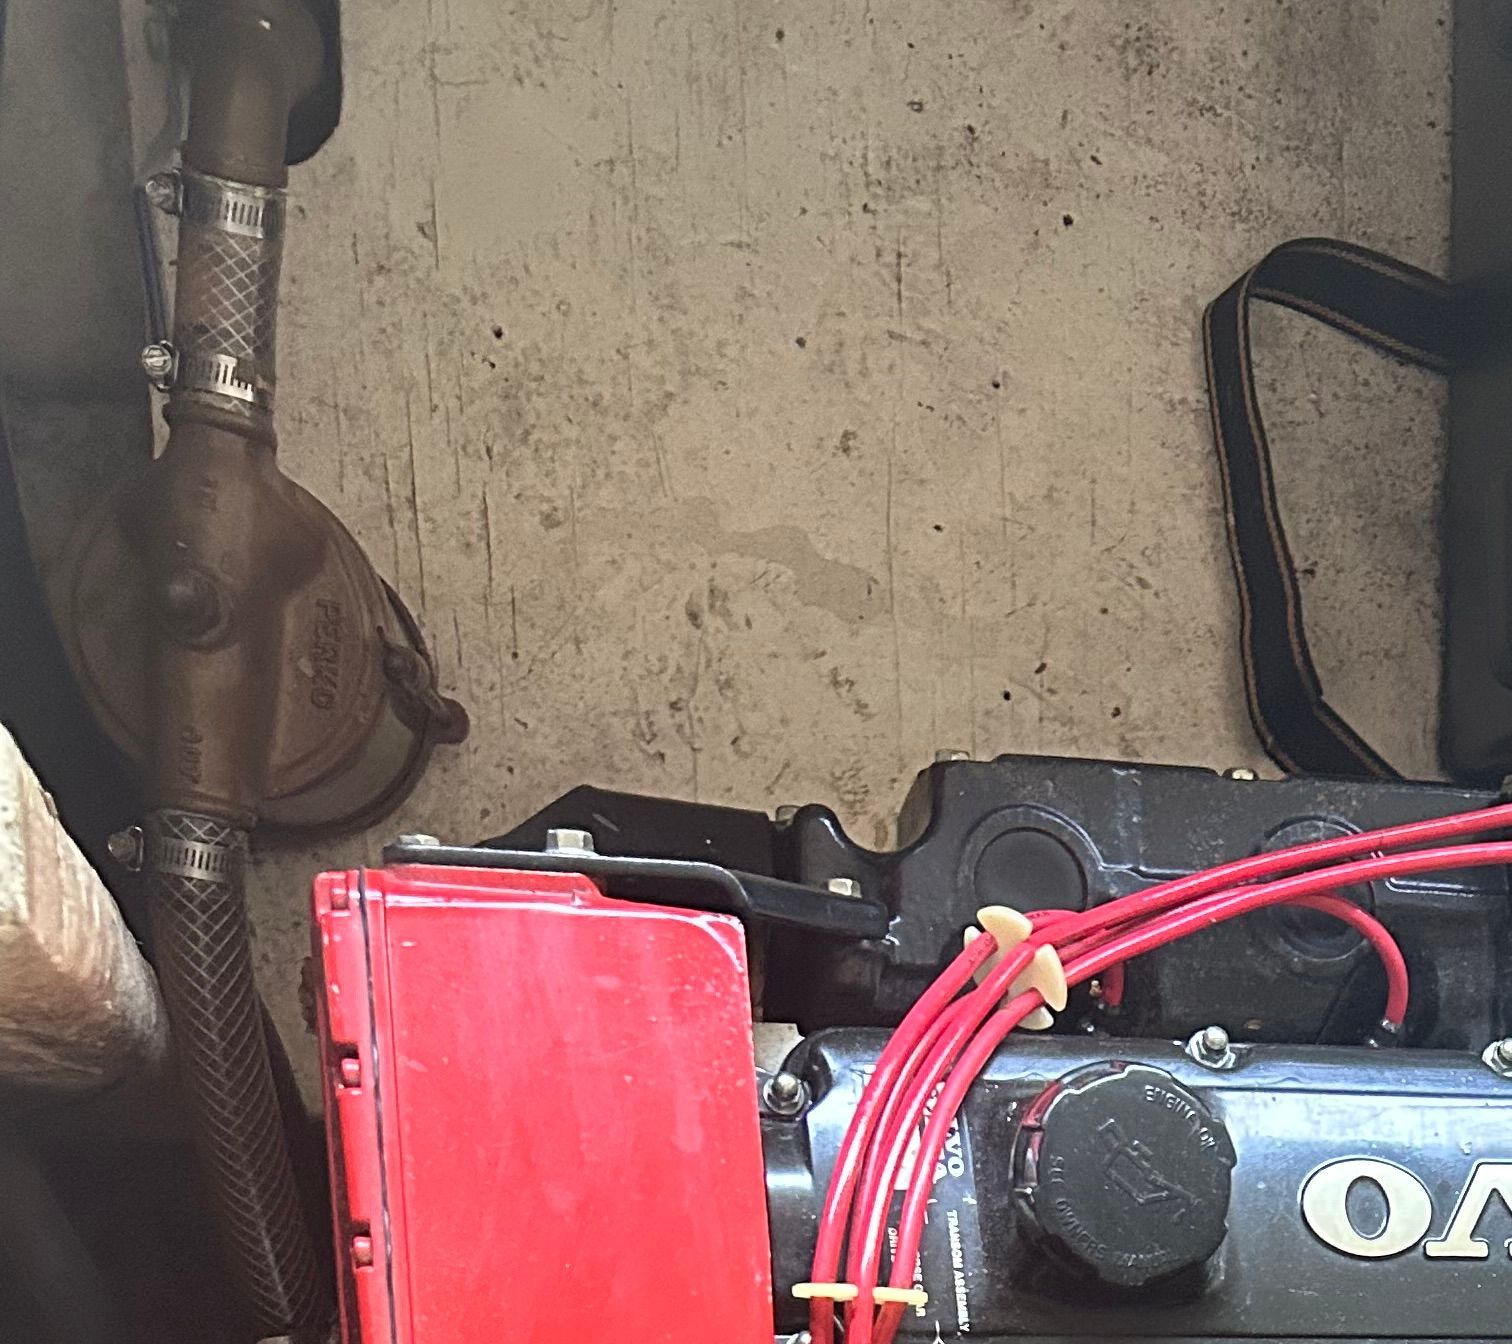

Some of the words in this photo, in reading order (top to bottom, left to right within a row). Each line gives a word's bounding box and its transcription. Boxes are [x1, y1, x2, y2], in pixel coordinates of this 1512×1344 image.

[310, 599, 341, 711] PERKO
[947, 1210, 964, 1269] TRANSOM
[953, 1270, 970, 1332] ASSEMBLY
